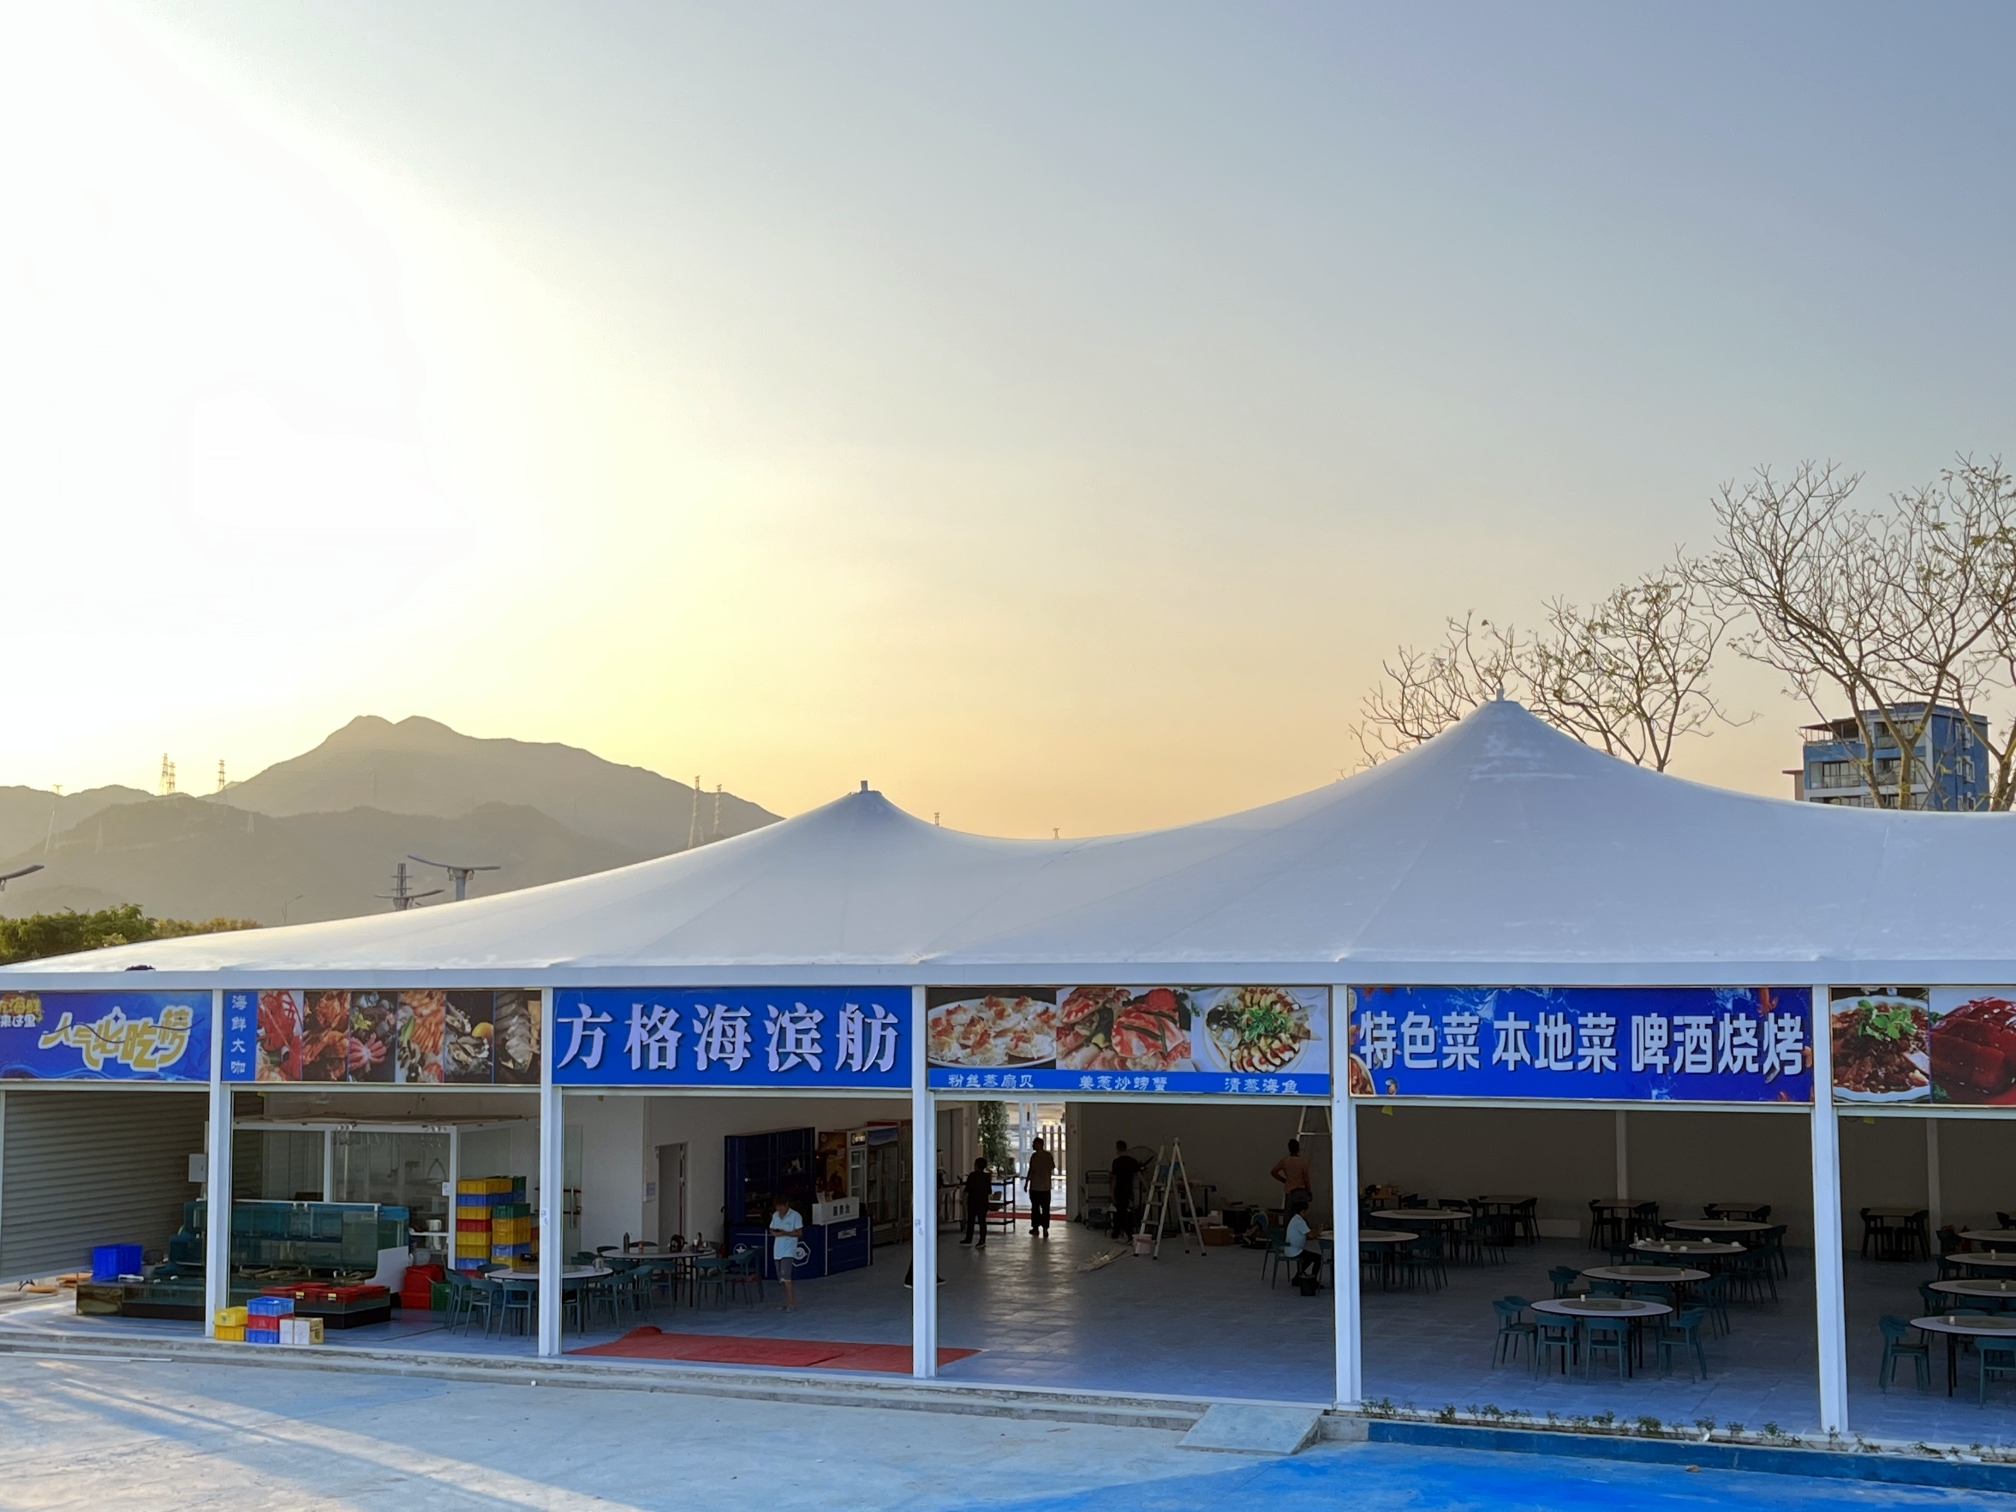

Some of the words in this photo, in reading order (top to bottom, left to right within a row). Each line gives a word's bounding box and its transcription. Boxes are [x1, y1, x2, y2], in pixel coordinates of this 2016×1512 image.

[39, 1005, 194, 1072] 人气必吃榜
[231, 994, 247, 1075] 海鲜大咖
[557, 1002, 899, 1072] 方格海滨舫
[1360, 1011, 1480, 1069] 特色菜
[1492, 1012, 1618, 1073] 本地菜
[1631, 1012, 1804, 1076] 啤酒烧烤
[947, 1073, 1035, 1089] 粉丝蒸扇贝
[1078, 1075, 1167, 1092] 姜葱炒螃蟹
[1224, 1077, 1299, 1094] 清蒸海鱼
